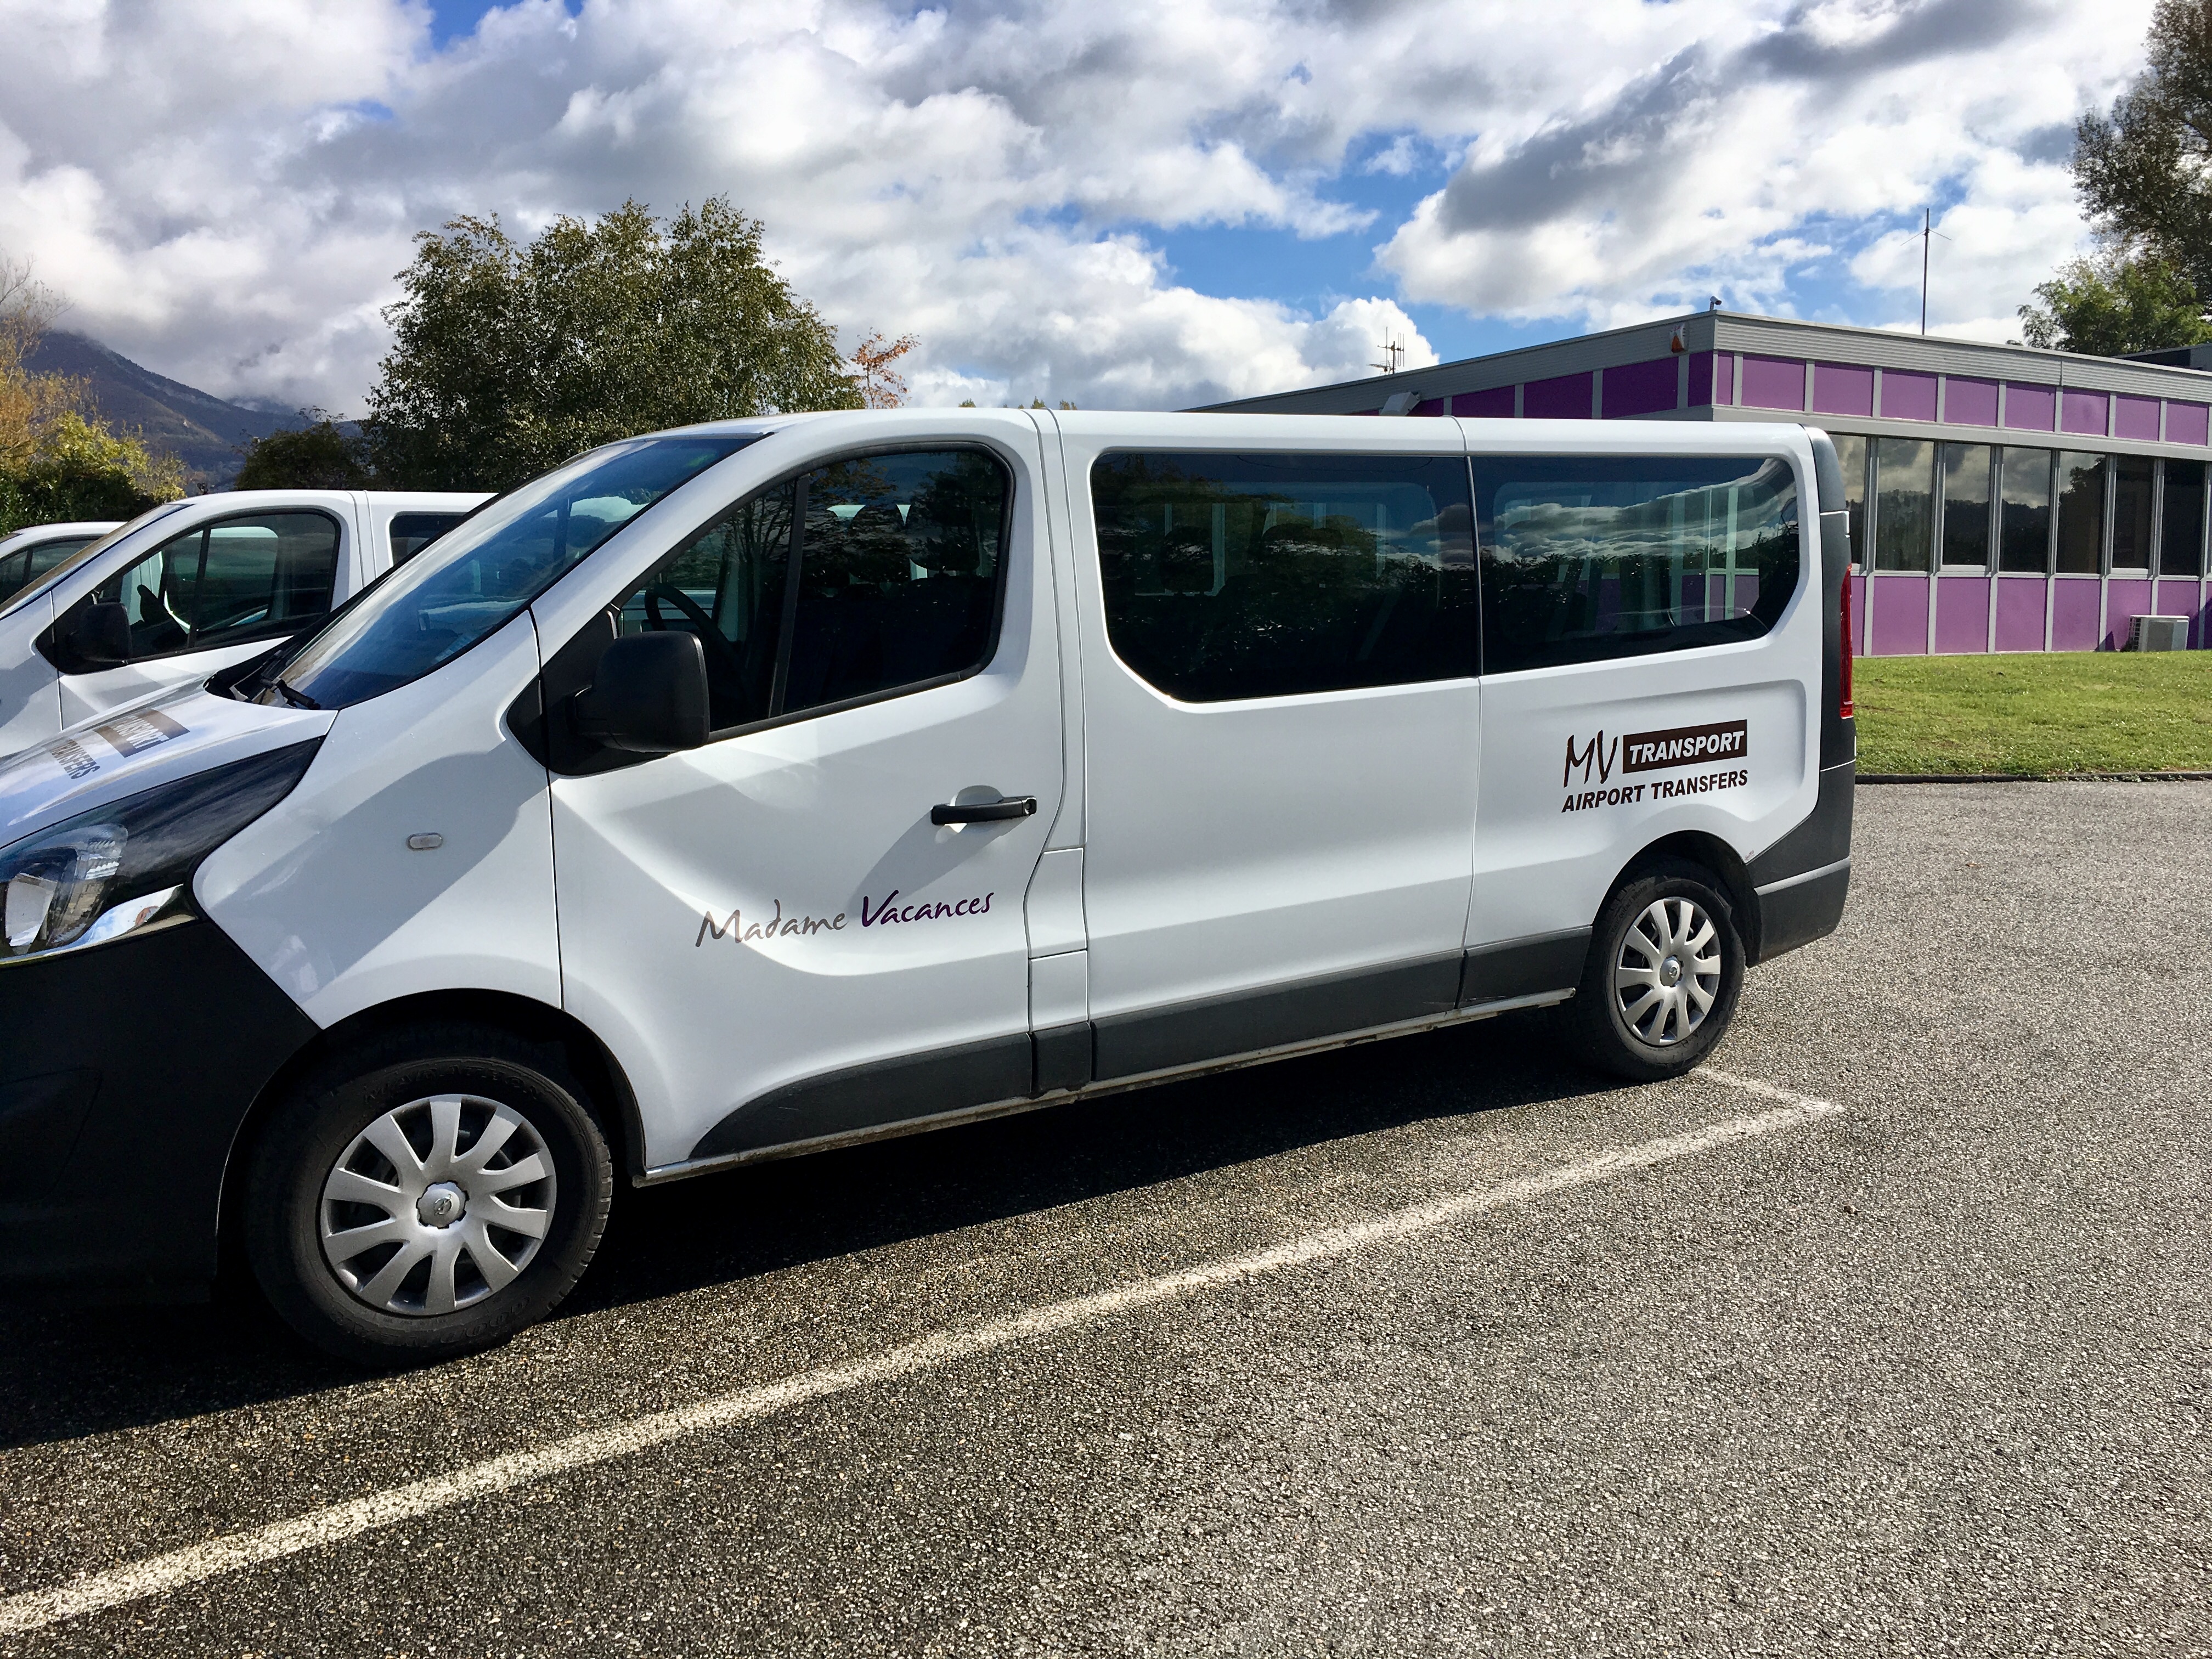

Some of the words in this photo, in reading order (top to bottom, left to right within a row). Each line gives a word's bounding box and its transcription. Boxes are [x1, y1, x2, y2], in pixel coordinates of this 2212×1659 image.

[111, 714, 170, 749] RANSPORT
[1563, 730, 1618, 788] MV
[1629, 730, 1745, 765] TRANSPORT
[1561, 785, 1645, 813] AIRPORT
[1650, 769, 1748, 800] TRANSFERS
[695, 899, 849, 947] Madame
[861, 889, 994, 927] Vacances
